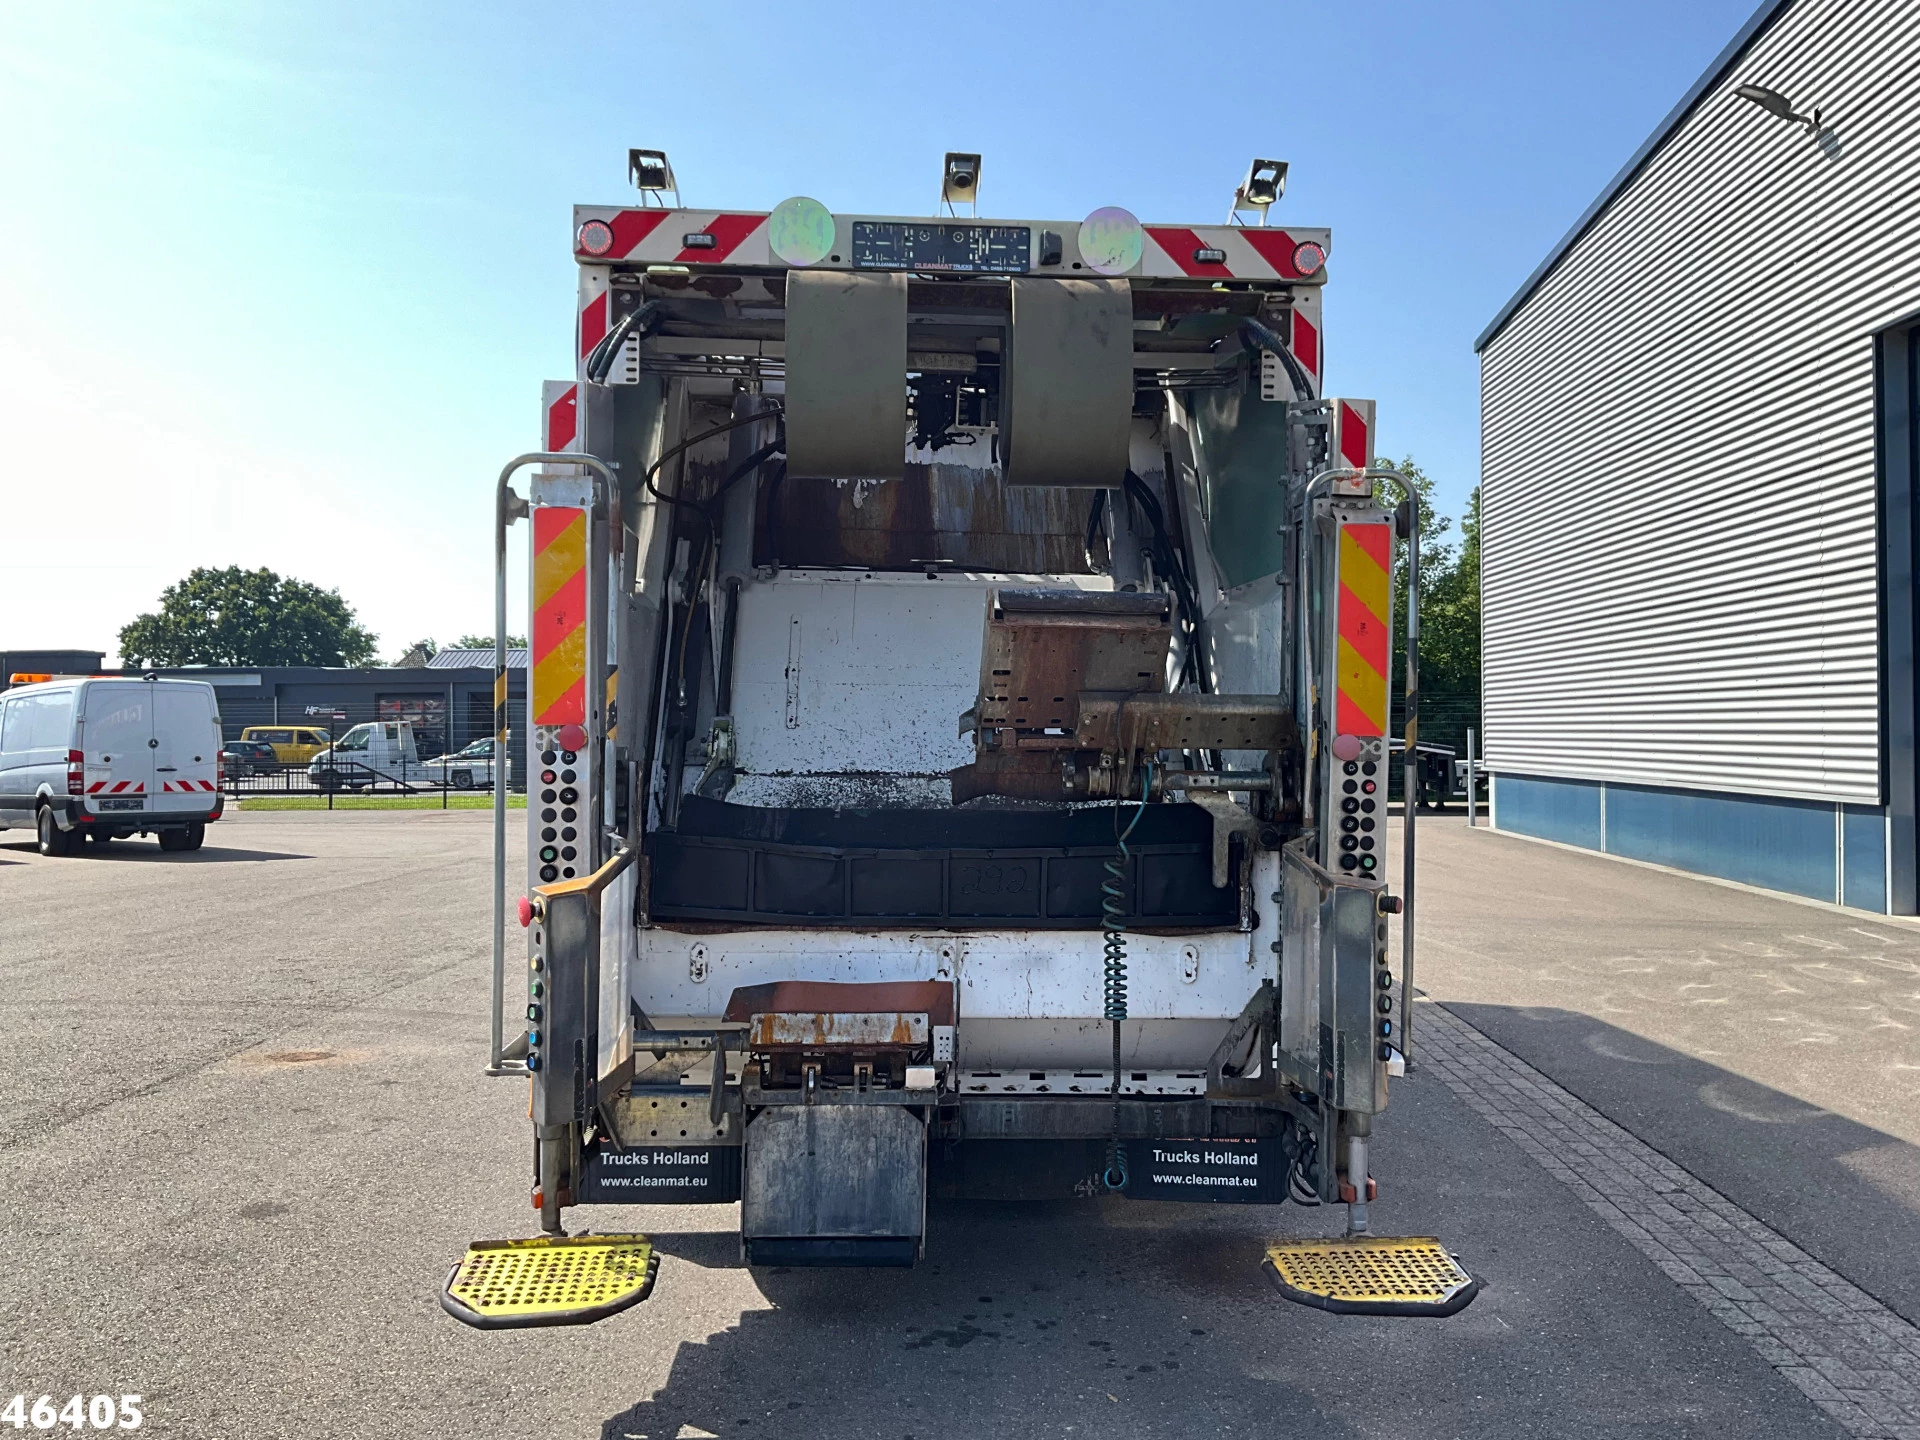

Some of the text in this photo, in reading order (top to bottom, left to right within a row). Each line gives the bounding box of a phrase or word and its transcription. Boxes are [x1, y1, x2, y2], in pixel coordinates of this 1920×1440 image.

[601, 1152, 709, 1165] Trucks Holland
[1153, 1149, 1258, 1165] Trucks Holland
[600, 1175, 708, 1186] www.cleanmat.eu
[1153, 1174, 1257, 1186] www.cleanmat.eu
